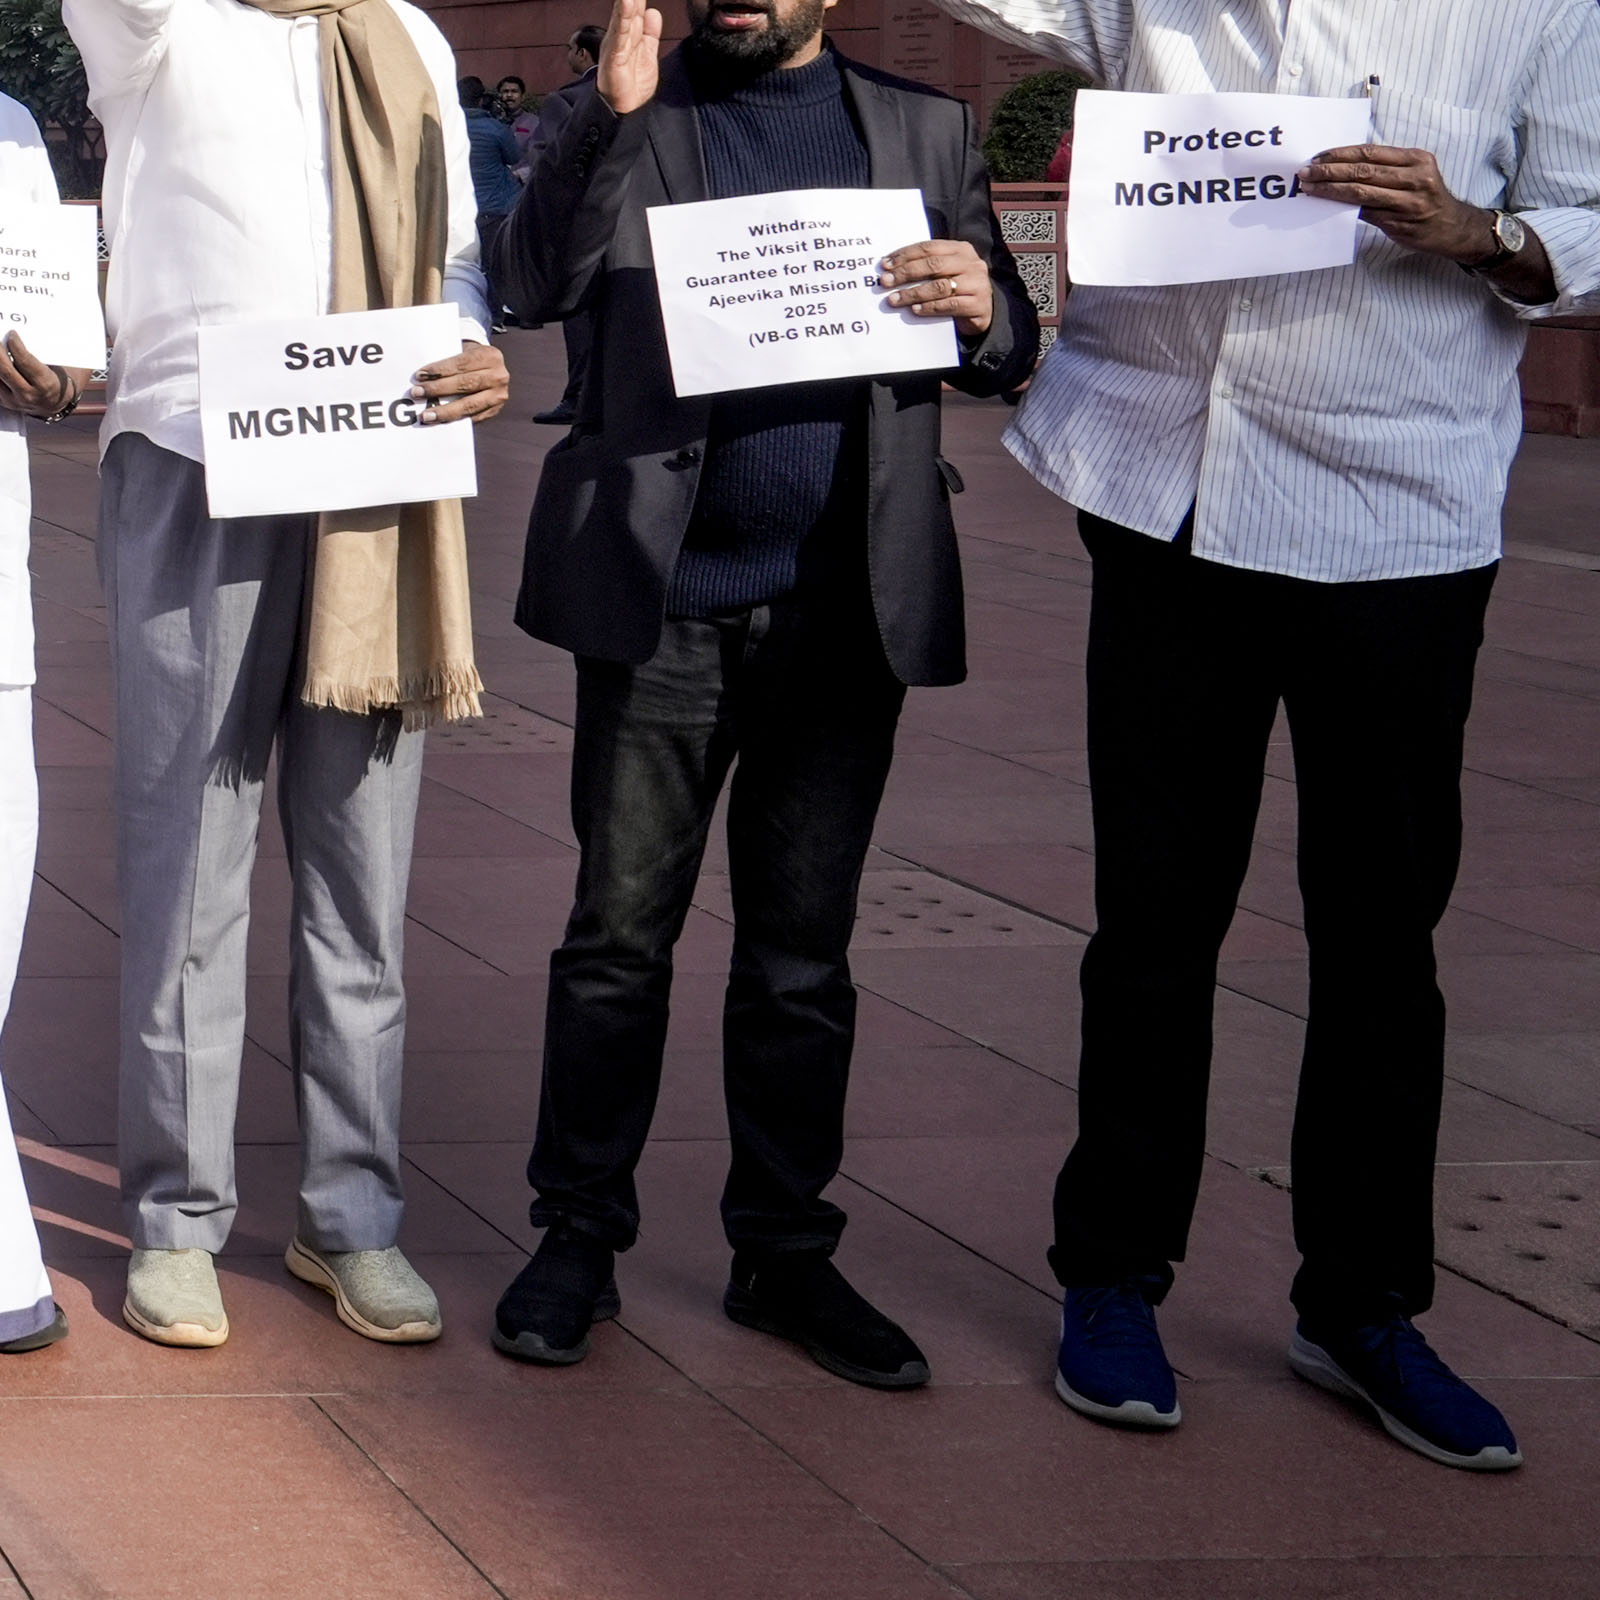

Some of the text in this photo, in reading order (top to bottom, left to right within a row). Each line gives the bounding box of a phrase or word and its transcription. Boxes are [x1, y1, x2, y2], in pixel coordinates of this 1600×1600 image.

[1144, 126, 1283, 153] Protect
[748, 220, 830, 236] Withdraw
[717, 237, 871, 262] The Viksit Bharat
[42, 271, 70, 281] and
[686, 257, 873, 288] Guarantee for Rozgar
[709, 289, 783, 308] Ajeevika
[790, 280, 857, 296] Mission
[10, 313, 27, 324] G)
[784, 303, 827, 318] 2025
[749, 321, 869, 348] (VB-G RAM G)
[285, 343, 383, 370] Save
